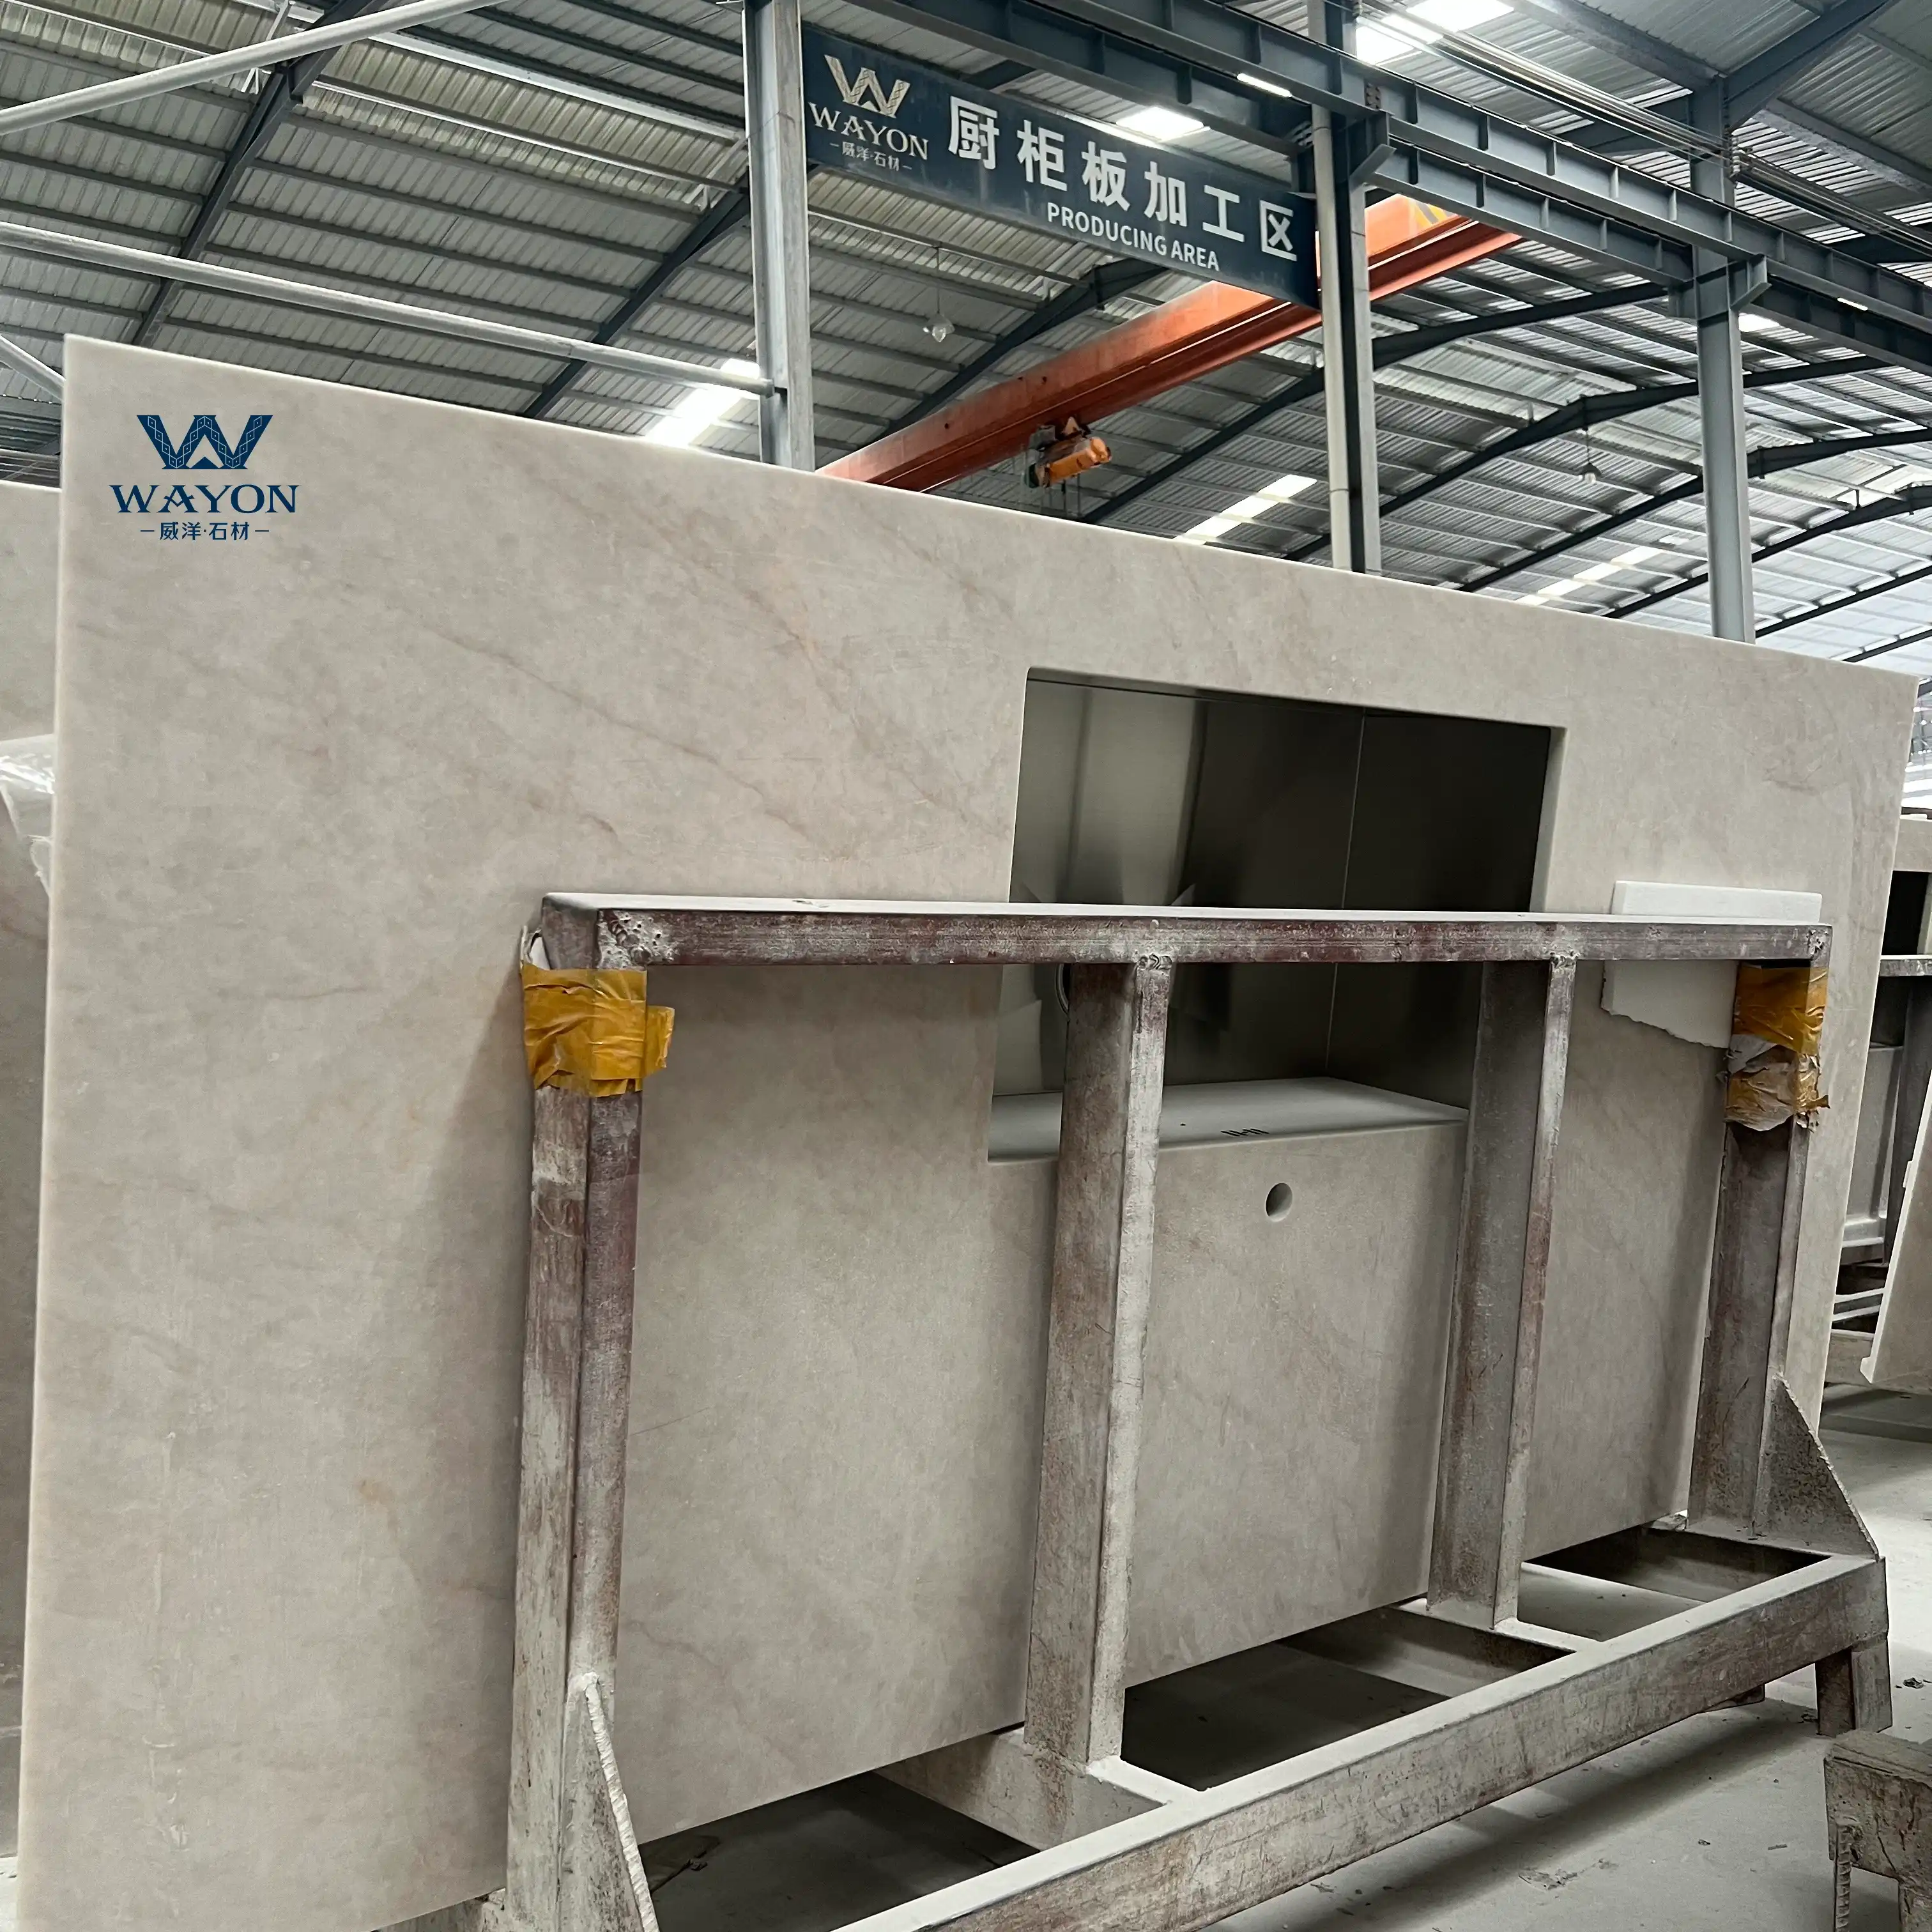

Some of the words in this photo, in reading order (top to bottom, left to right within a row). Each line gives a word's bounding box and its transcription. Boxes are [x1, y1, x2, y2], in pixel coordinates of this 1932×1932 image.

[808, 102, 929, 160] WAYON
[947, 96, 1297, 261] 厨柜板加工区
[1047, 202, 1167, 256] PRODUCING
[1170, 240, 1220, 272] AREA
